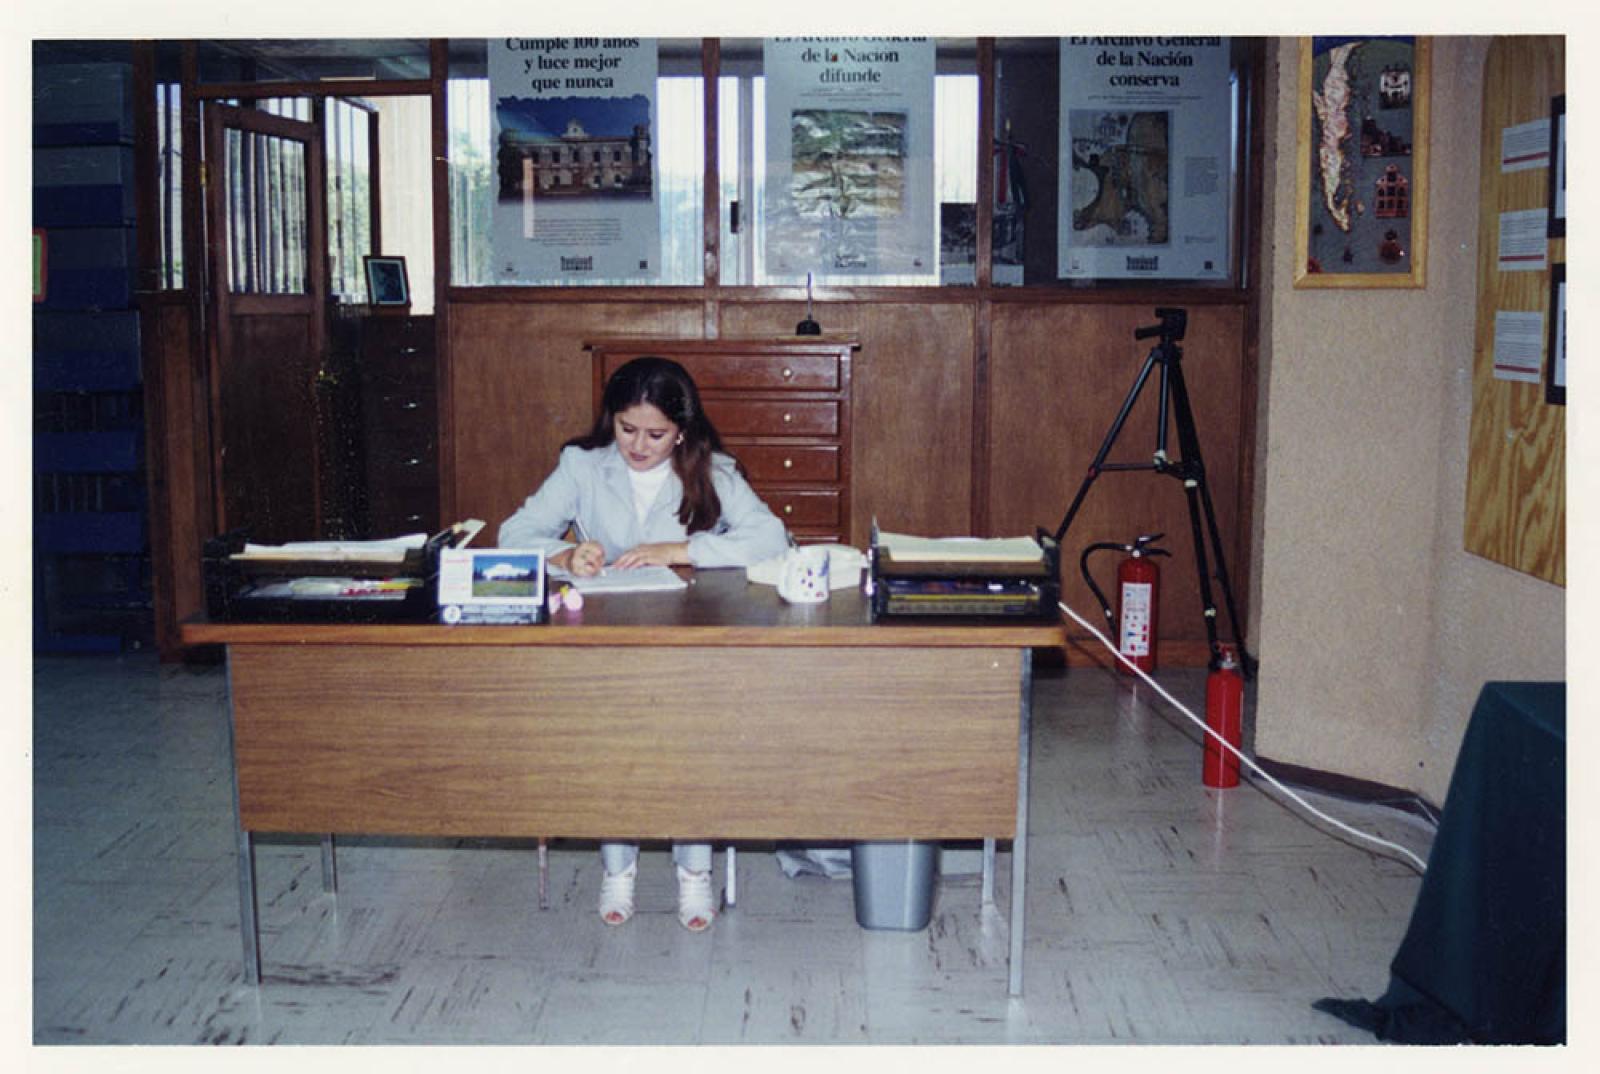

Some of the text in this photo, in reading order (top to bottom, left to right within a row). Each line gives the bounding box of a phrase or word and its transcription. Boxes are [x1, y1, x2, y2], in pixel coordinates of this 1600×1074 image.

[505, 38, 570, 53] Cumple
[573, 37, 599, 49] 100
[801, 48, 821, 62] de
[1096, 51, 1193, 67] de la Nación
[524, 53, 621, 74] y luce mejor
[819, 68, 882, 83] difunde
[1109, 74, 1180, 87] conserva
[532, 77, 614, 93] que nunca
